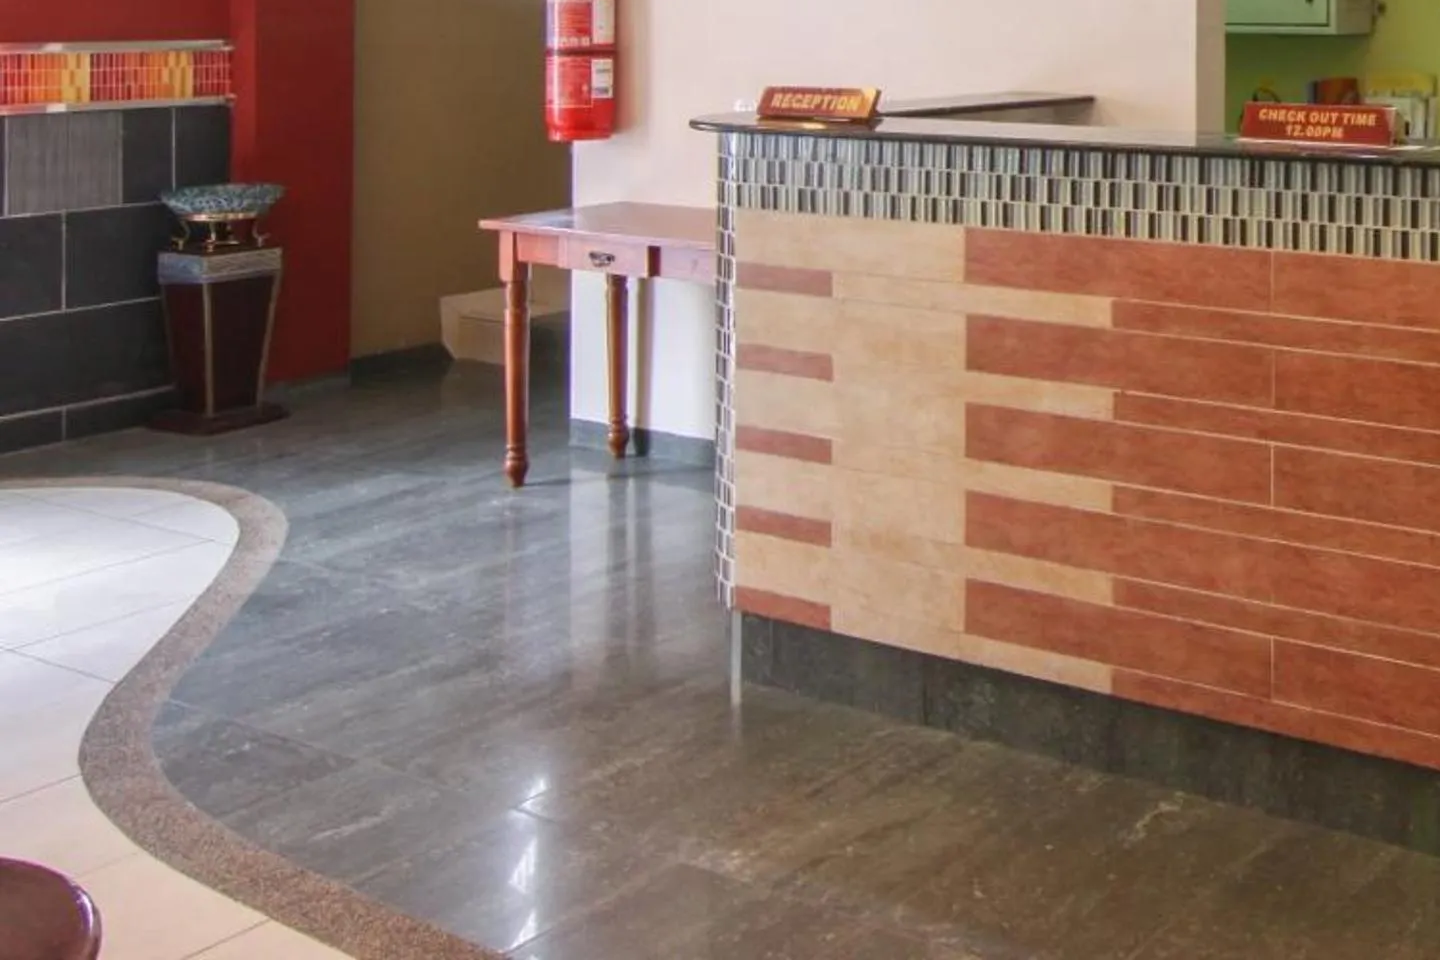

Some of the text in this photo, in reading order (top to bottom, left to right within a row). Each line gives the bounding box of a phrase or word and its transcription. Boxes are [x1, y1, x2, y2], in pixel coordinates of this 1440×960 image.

[770, 92, 862, 112] RECEPTION
[1258, 108, 1378, 128] CHECK OUT TIME
[1285, 124, 1345, 139] 12.00PM
